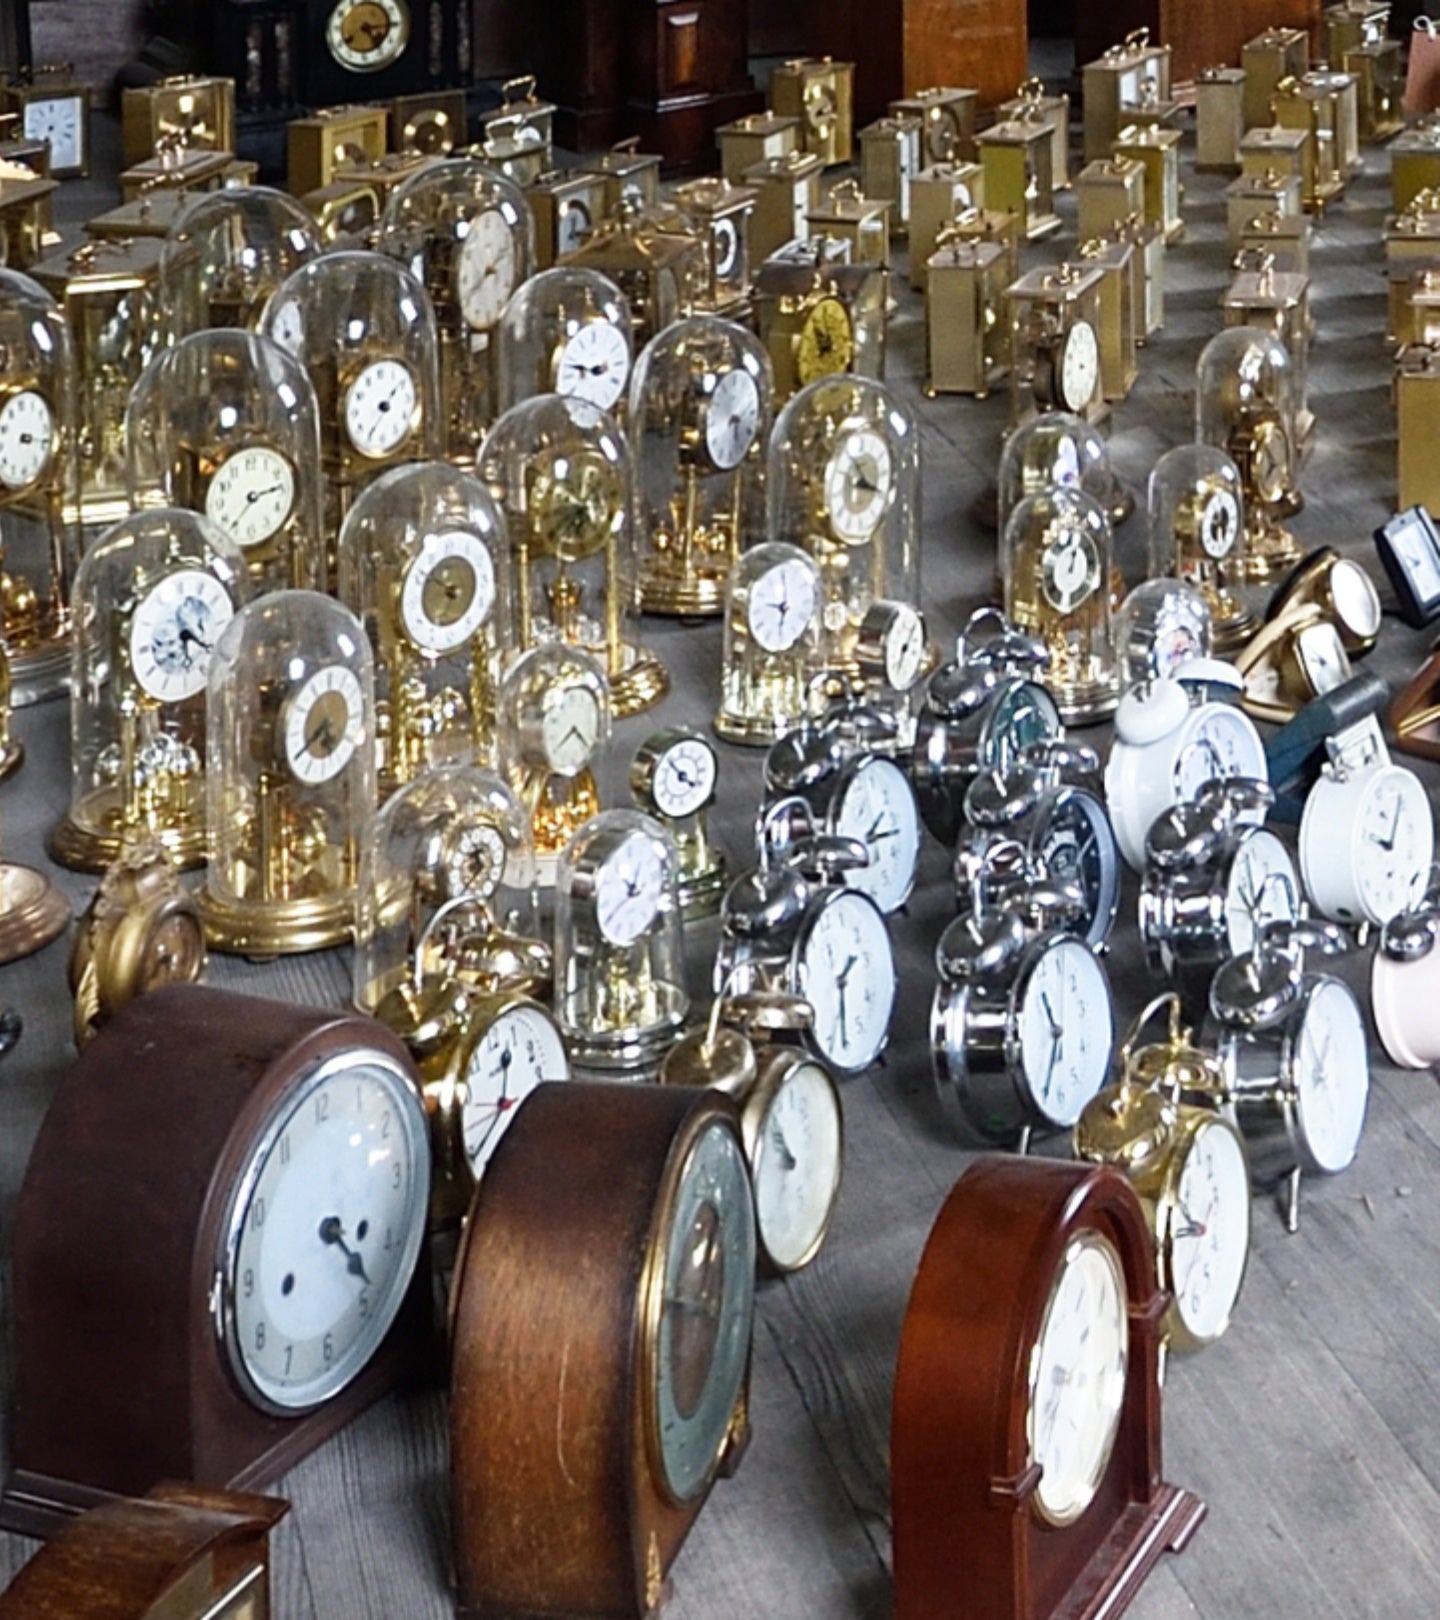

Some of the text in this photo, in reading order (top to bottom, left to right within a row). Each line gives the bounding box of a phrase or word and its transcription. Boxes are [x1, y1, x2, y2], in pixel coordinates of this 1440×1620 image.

[1070, 973, 1077, 993] 2
[1070, 1067, 1080, 1086] 5
[314, 1092, 329, 1125] 12
[381, 1110, 391, 1139] 2
[279, 1137, 291, 1165] 11
[392, 1162, 402, 1190] 3
[249, 1197, 265, 1232] 10
[243, 1268, 254, 1298] 9
[255, 1322, 266, 1352] 8
[322, 1333, 333, 1361] 6
[282, 1345, 294, 1376] 7
